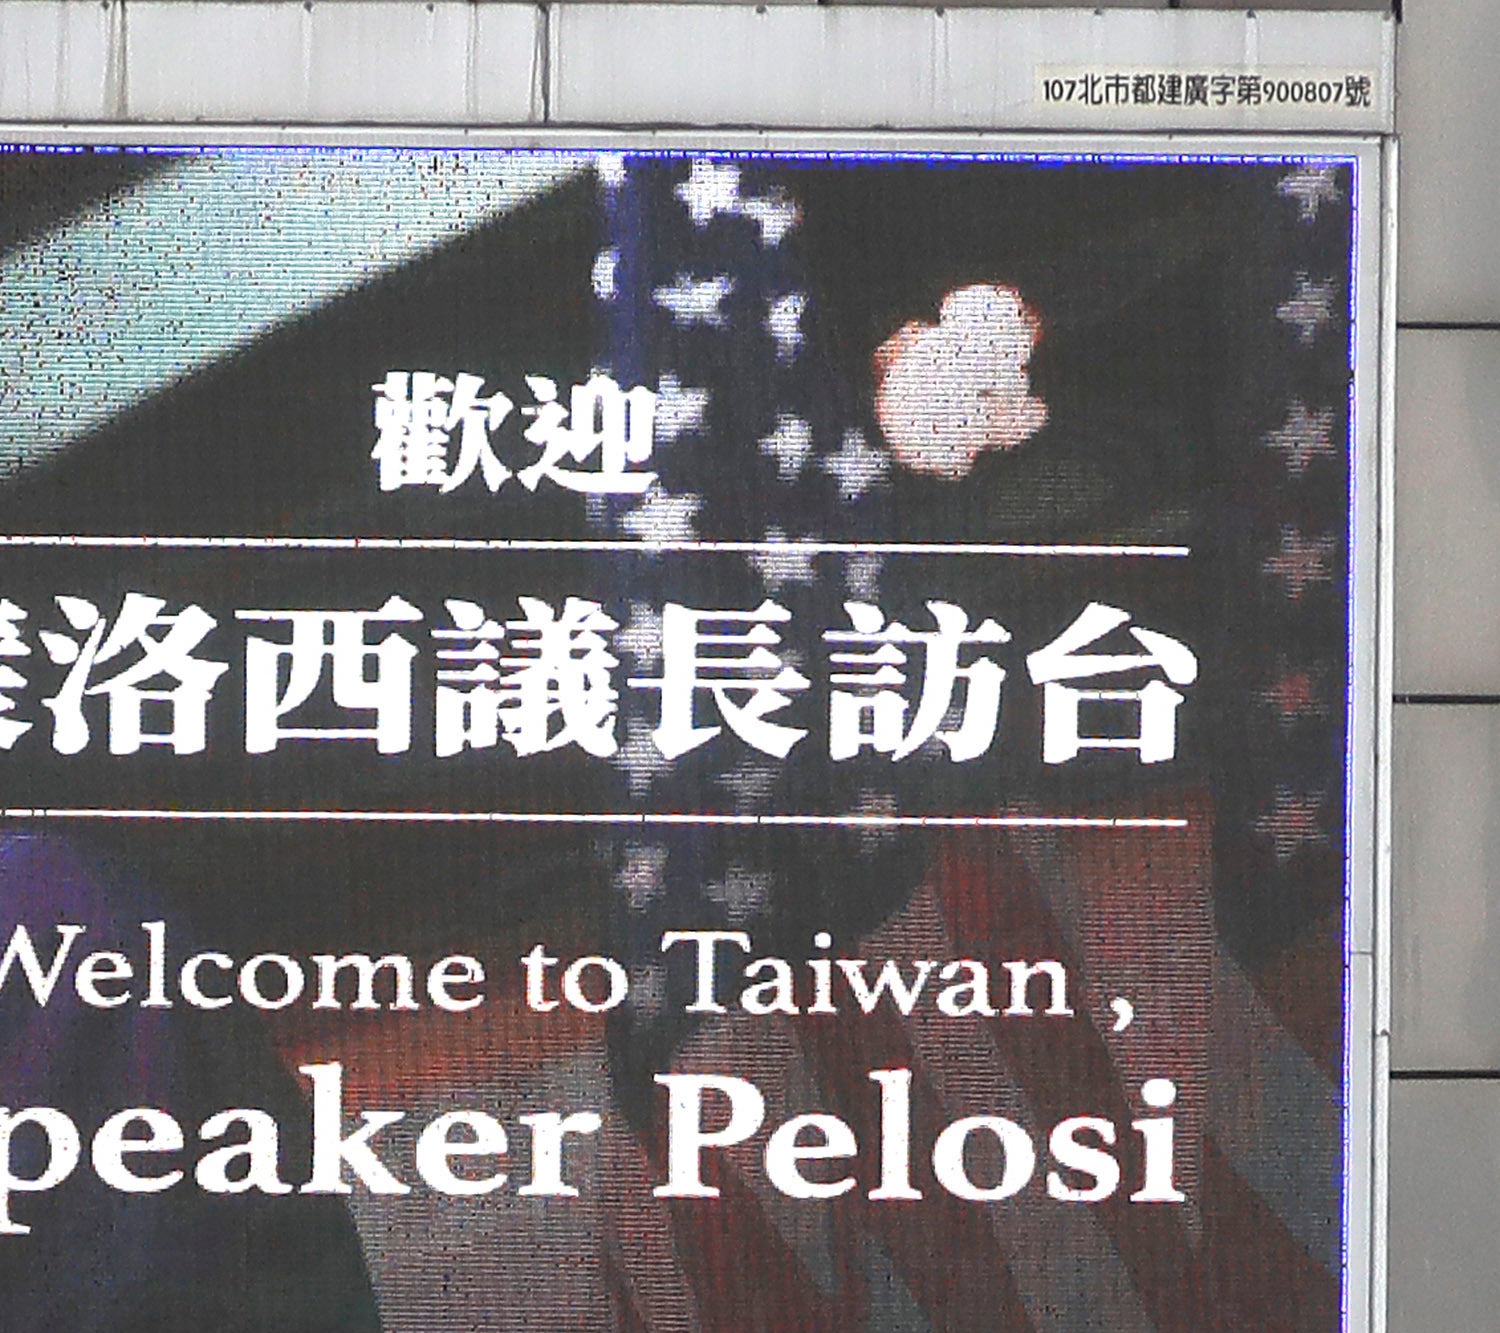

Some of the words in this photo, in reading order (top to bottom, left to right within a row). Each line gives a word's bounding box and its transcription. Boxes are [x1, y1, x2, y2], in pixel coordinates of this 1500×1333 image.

[1043, 75, 1371, 106] 107北市都建廣字第900807號
[371, 373, 659, 497] 歡迎
[523, 938, 630, 1014] to
[662, 930, 1075, 1019] Taiwan
[654, 1066, 1184, 1205] Pelosi
